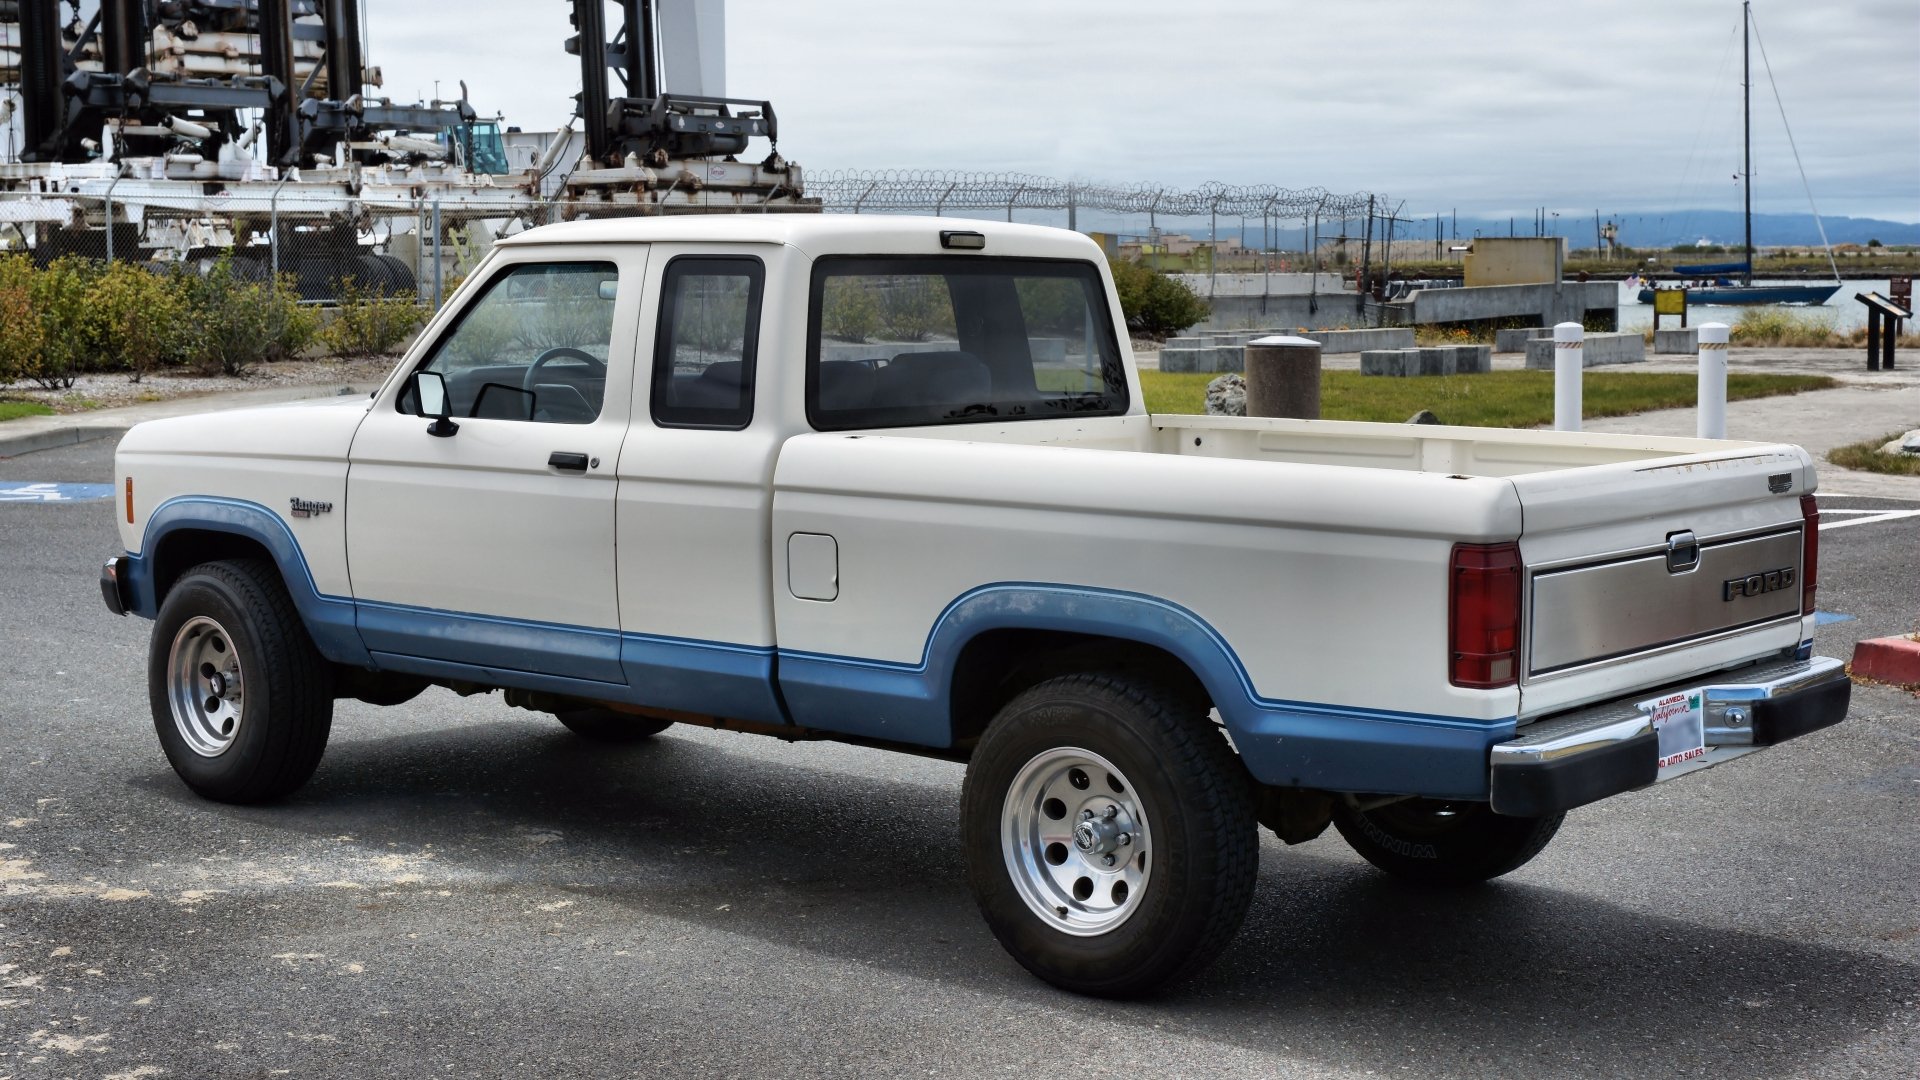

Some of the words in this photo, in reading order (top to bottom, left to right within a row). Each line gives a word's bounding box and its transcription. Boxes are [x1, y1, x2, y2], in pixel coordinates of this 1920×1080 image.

[1723, 567, 1795, 602] FORD
[1659, 694, 1685, 706] ALAMEDA
[1667, 754, 1683, 766] AUTO
[1684, 748, 1704, 760] SALES
